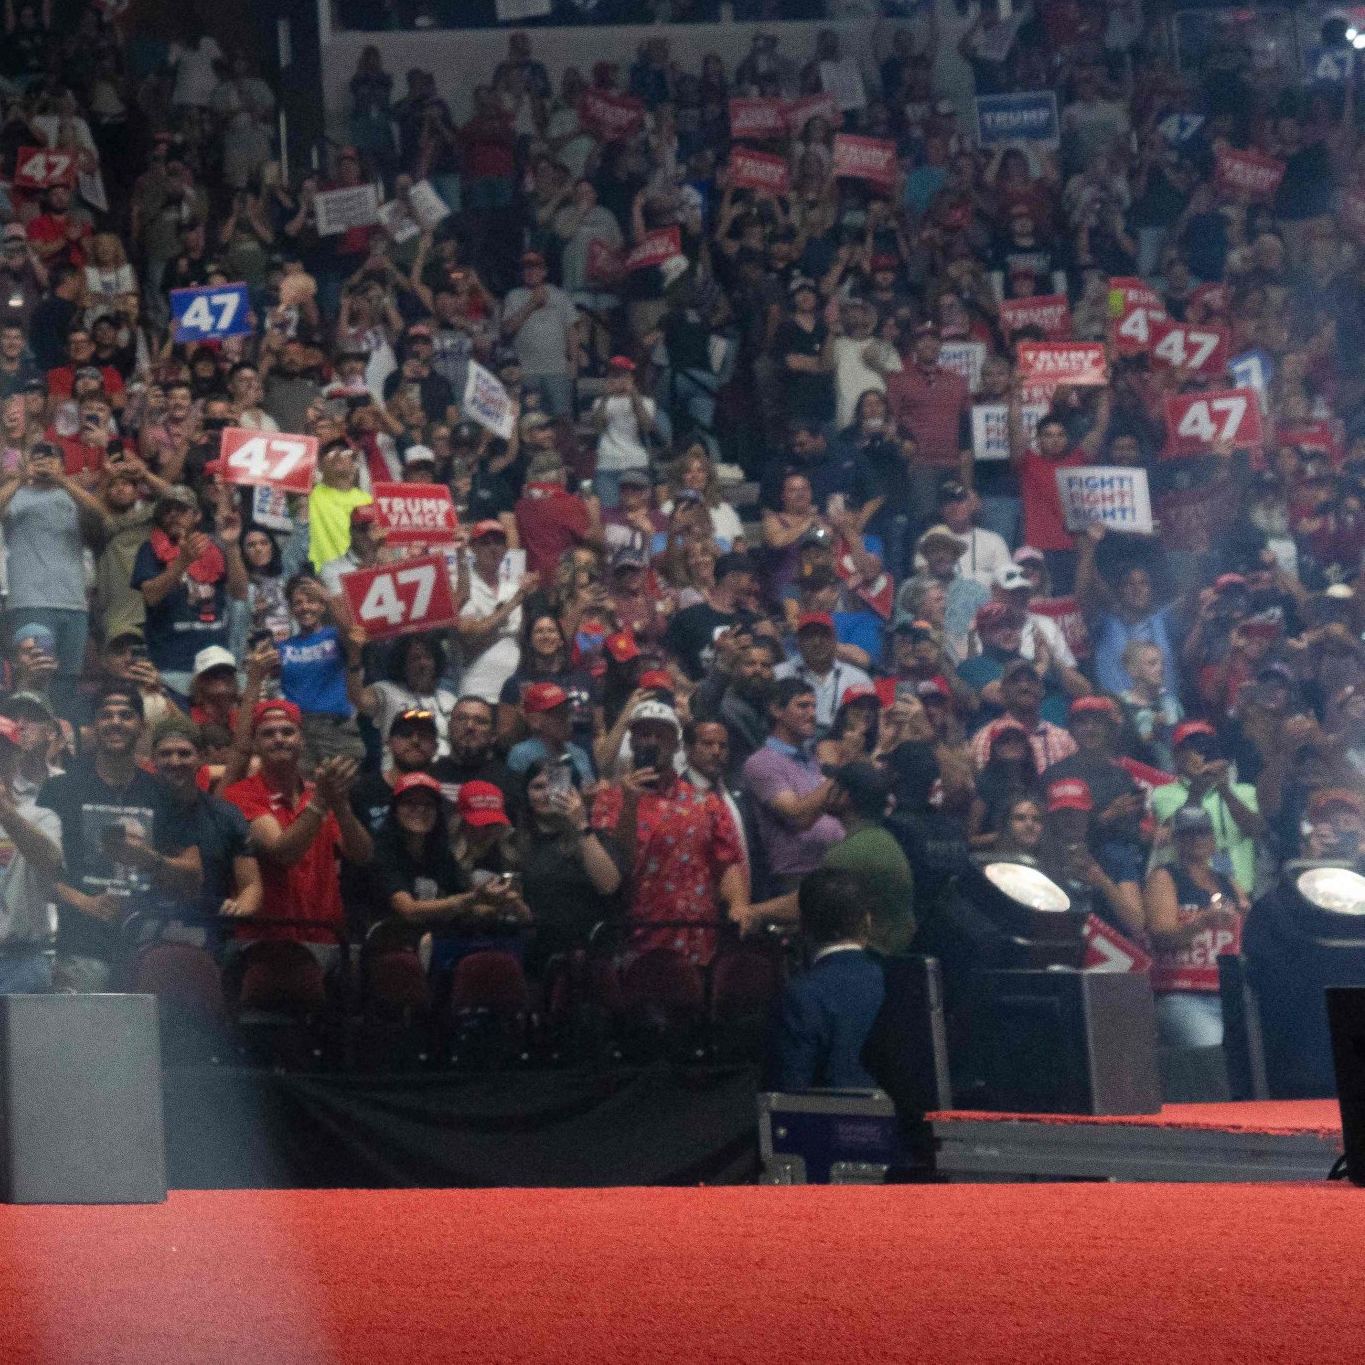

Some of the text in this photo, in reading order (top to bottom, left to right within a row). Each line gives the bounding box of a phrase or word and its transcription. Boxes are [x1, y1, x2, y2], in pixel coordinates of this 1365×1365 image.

[21, 153, 71, 183] 47
[181, 292, 241, 332] 47
[1155, 331, 1220, 370] 47
[1178, 397, 1248, 441] 47
[229, 437, 307, 480] 47
[377, 497, 450, 514] TRUMP
[387, 511, 447, 528] VANCE
[360, 565, 437, 626] 47
